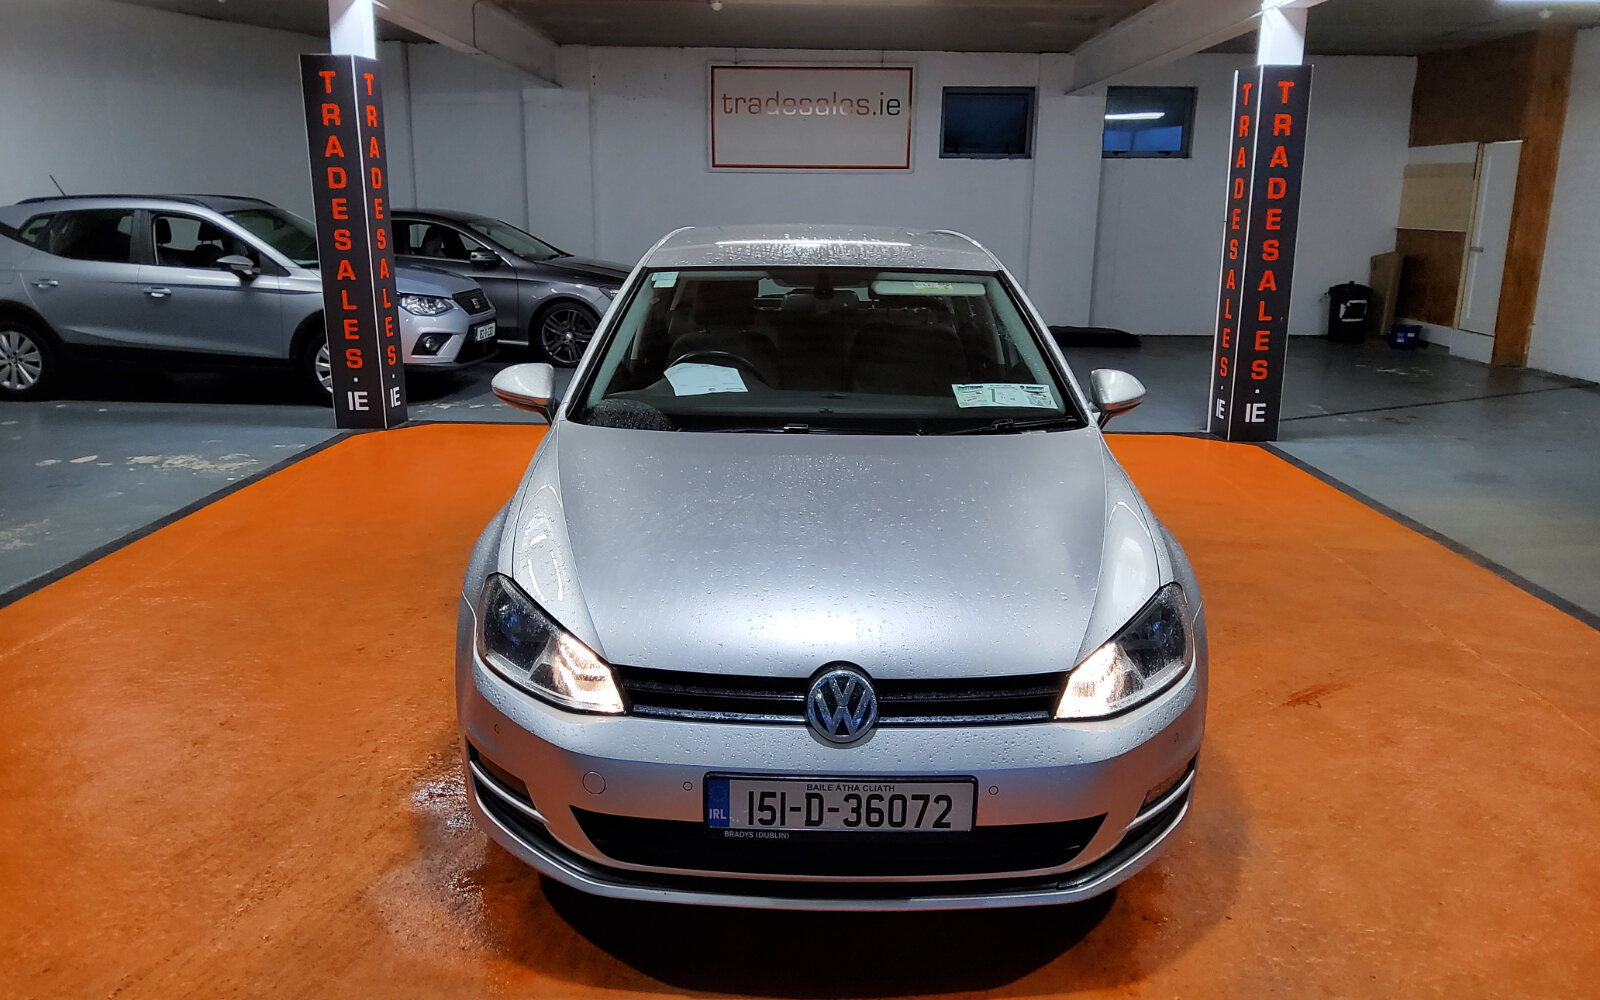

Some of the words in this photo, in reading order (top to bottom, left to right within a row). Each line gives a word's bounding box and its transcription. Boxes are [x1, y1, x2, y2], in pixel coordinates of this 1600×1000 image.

[721, 91, 901, 116] tradesales.ie
[806, 783, 833, 792] BAILE
[836, 782, 859, 792] ÁTHA
[862, 784, 895, 793] CLIATH
[709, 808, 727, 820] IRL
[748, 791, 953, 829] 151-D-36072
[724, 830, 754, 839] BRADYS
[756, 830, 790, 840] (DUBLIN)
